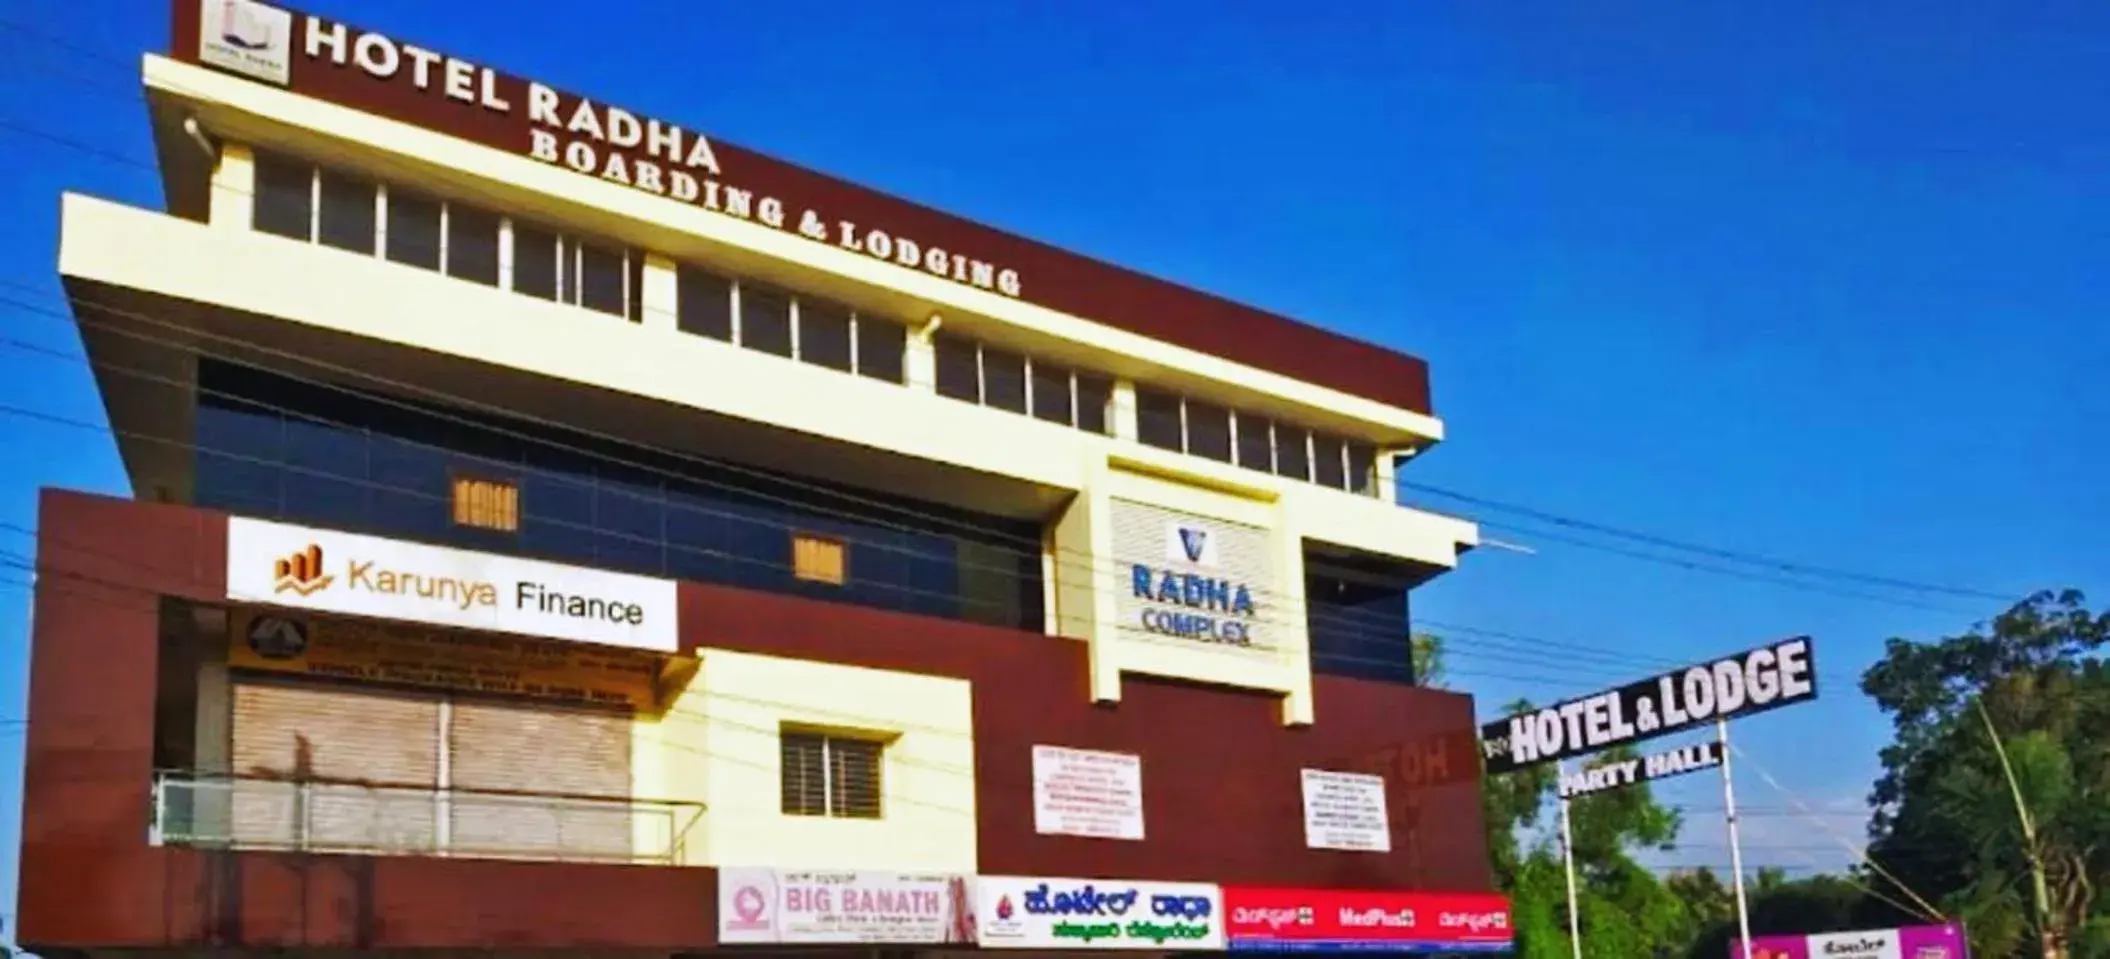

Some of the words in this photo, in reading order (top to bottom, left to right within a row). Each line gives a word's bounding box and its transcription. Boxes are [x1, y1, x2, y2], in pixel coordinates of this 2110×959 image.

[306, 16, 510, 111] HOTEL
[528, 81, 721, 174] RADHA
[530, 129, 784, 228] BOARDING
[800, 210, 827, 240] &
[840, 221, 1021, 297] LODGING
[348, 559, 498, 610] Karunya
[515, 581, 643, 625] Finance
[1132, 563, 1255, 616] RADHA
[1141, 608, 1250, 645] COMPLEX
[1510, 691, 1633, 764] HOTEL
[1635, 697, 1659, 732] &
[1659, 641, 1812, 726] LODGE
[1558, 759, 1639, 797] PARTY
[1647, 743, 1719, 777] HALL
[786, 887, 831, 912] BIG
[842, 889, 940, 913] BANATH
